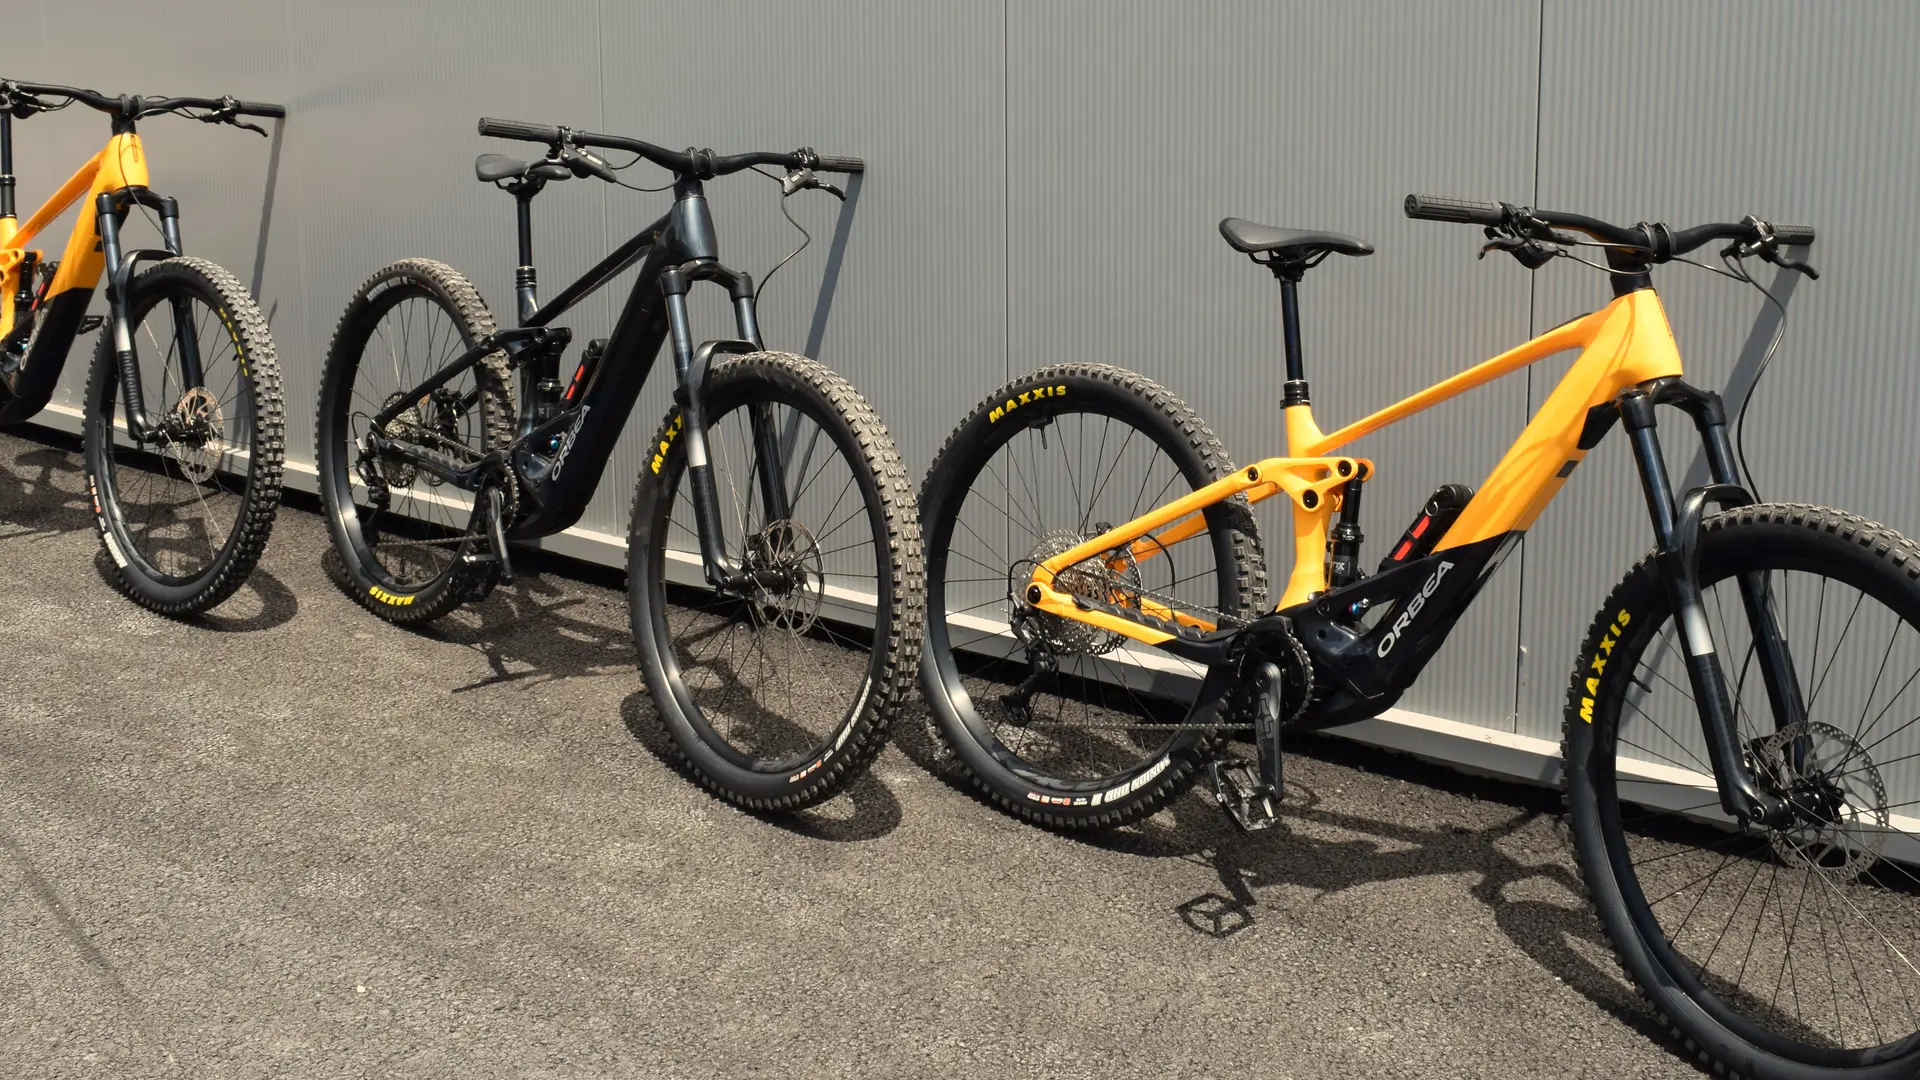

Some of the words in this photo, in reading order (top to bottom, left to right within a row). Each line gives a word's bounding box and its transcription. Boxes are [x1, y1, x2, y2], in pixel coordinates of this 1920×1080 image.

[989, 385, 1066, 423] MAXXIS
[552, 405, 591, 481] ORBEA
[651, 414, 682, 474] MAXX
[369, 586, 415, 605] MAXXIS
[1377, 560, 1454, 658] ORBEA
[1580, 608, 1631, 723] MAXXIS
